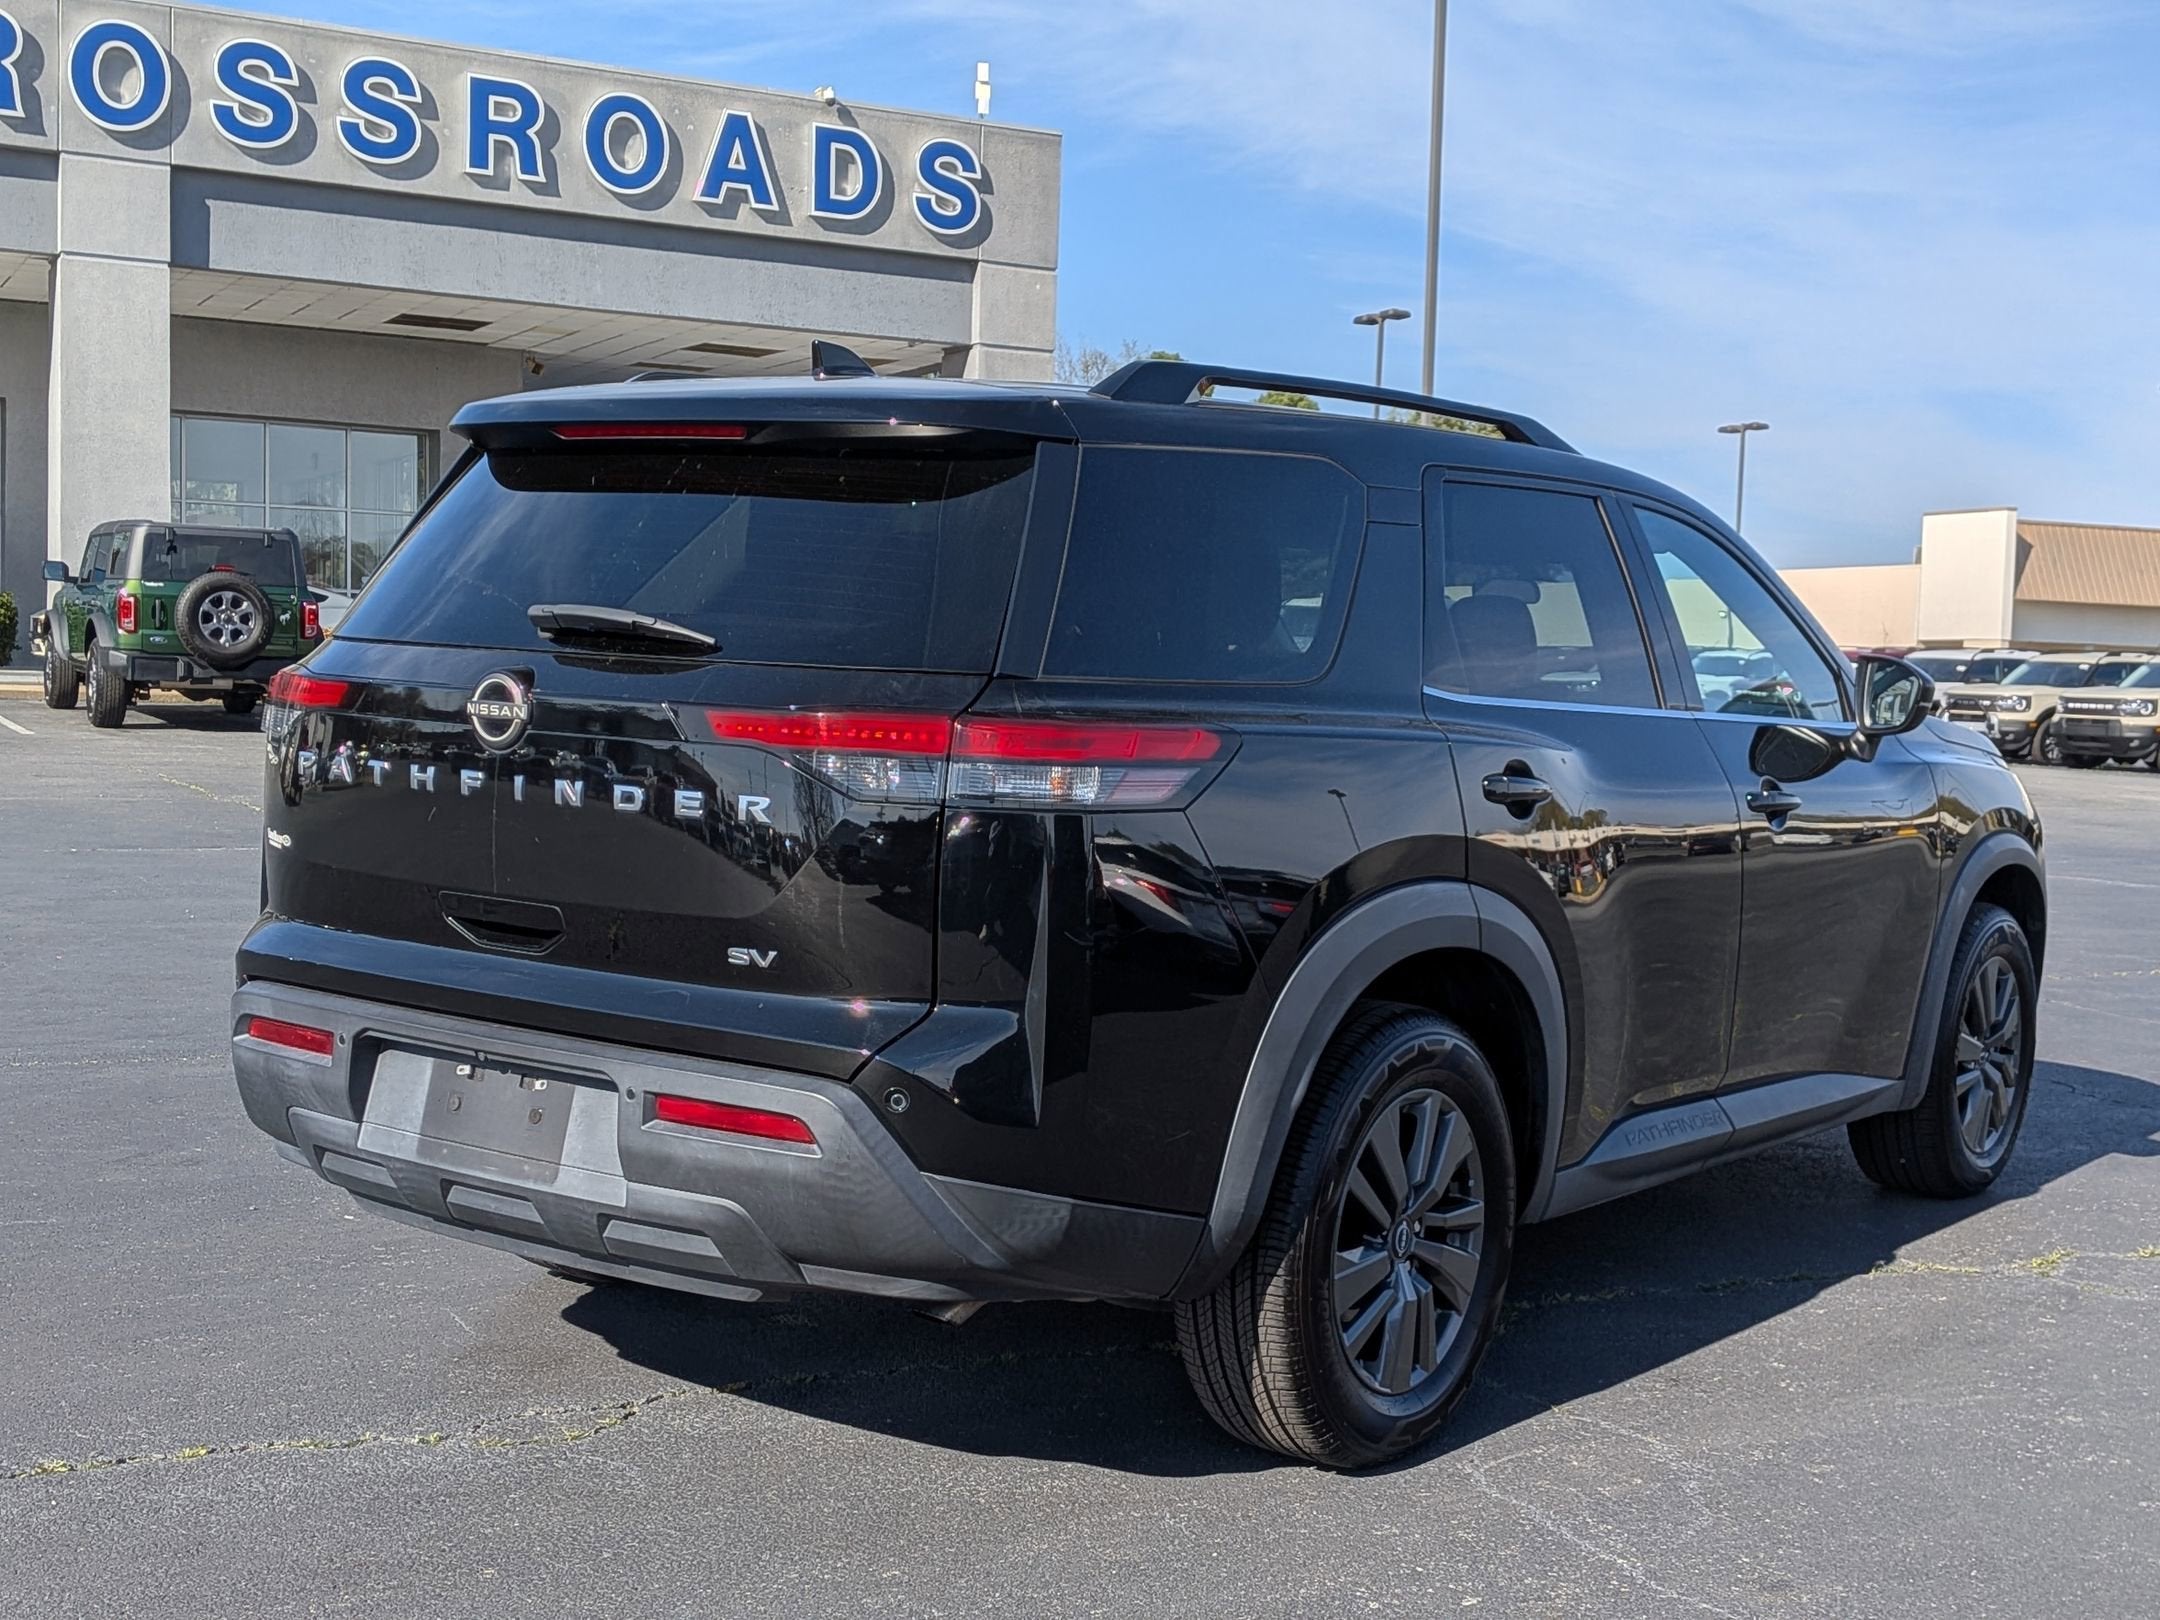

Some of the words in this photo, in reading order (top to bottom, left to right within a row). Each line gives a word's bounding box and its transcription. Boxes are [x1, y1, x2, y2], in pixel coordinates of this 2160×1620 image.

[0, 8, 982, 234] OSSROADS
[467, 702, 527, 719] NISSAN
[298, 751, 772, 824] PATHFINDER
[728, 947, 778, 968] SV
[1624, 1111, 1727, 1147] PATHFINDER
